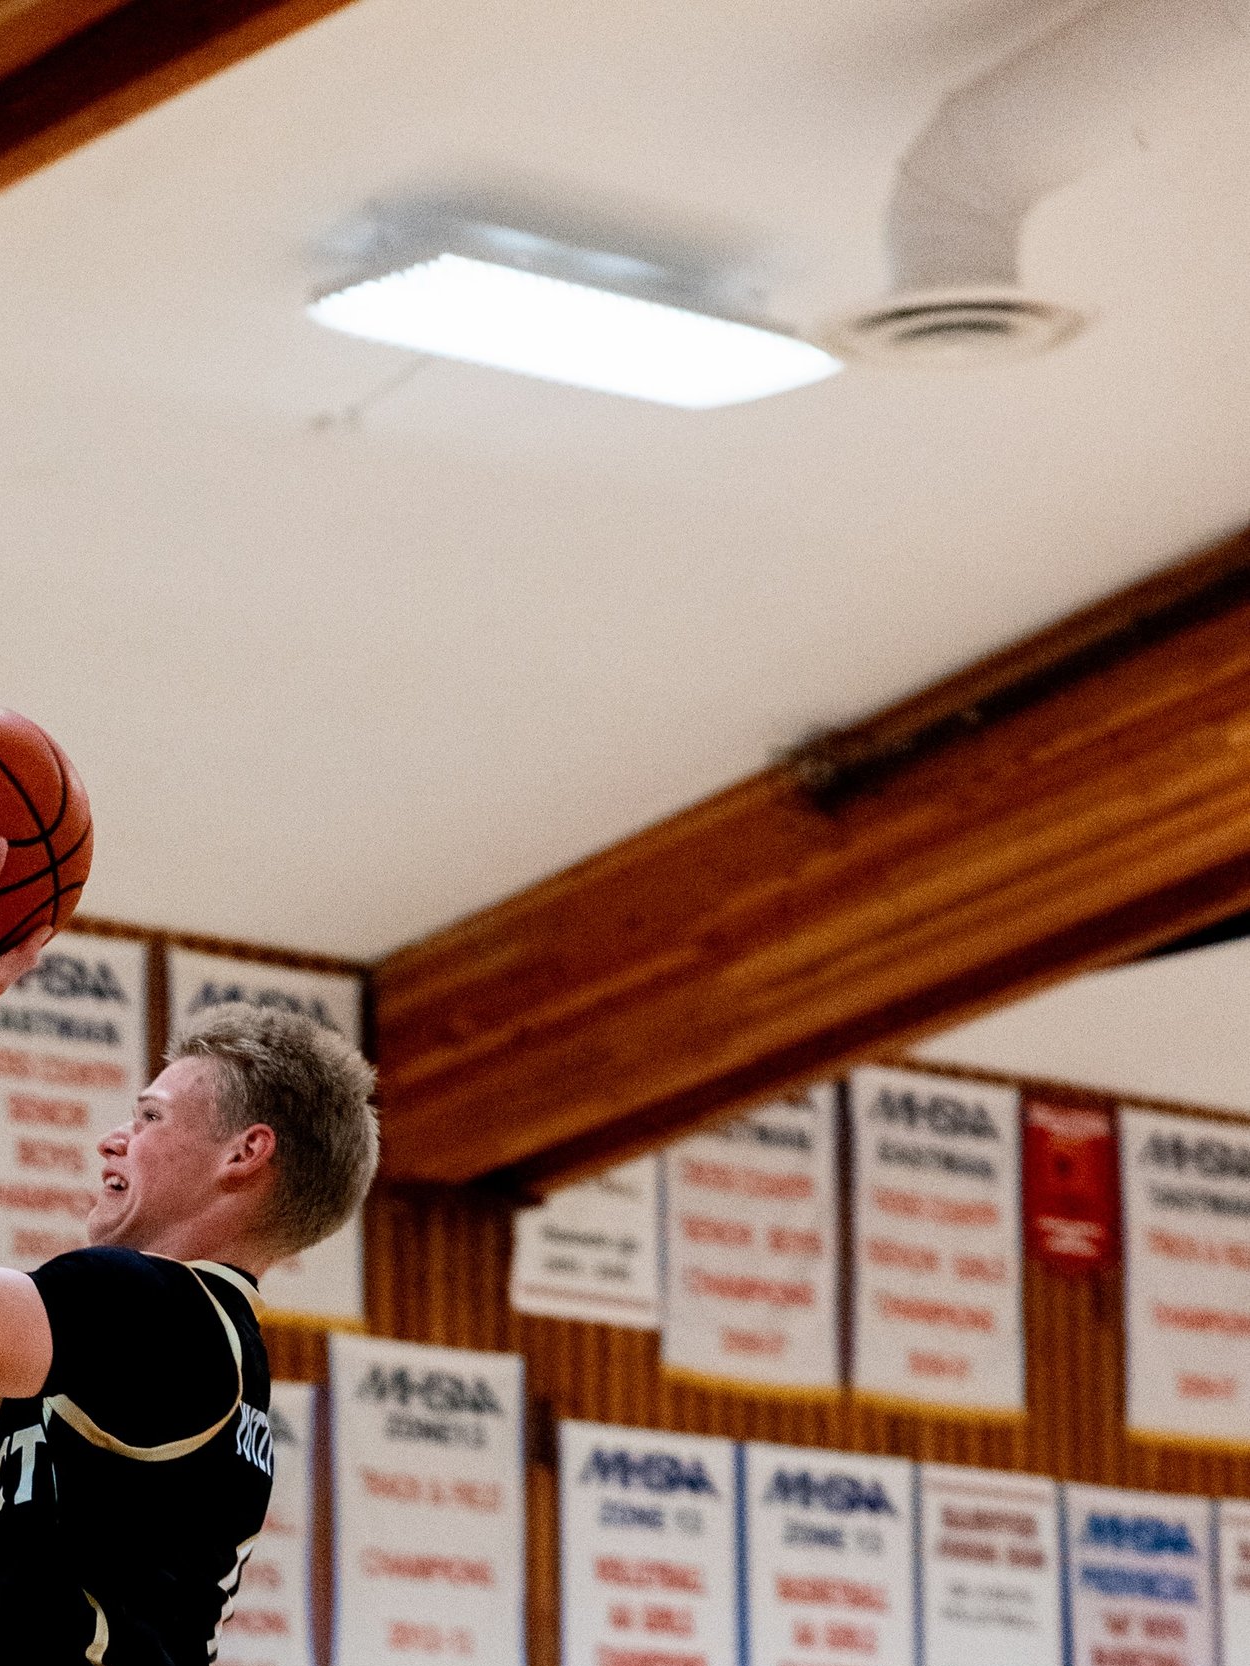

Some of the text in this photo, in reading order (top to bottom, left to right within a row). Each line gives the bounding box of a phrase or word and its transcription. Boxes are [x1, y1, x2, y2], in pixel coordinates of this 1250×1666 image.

[357, 1364, 503, 1418] MHSAA
[579, 1445, 720, 1501] MHSAA
[762, 1465, 899, 1520] MHSAA
[598, 1500, 666, 1532] ZONE
[781, 1519, 846, 1553] ZONE
